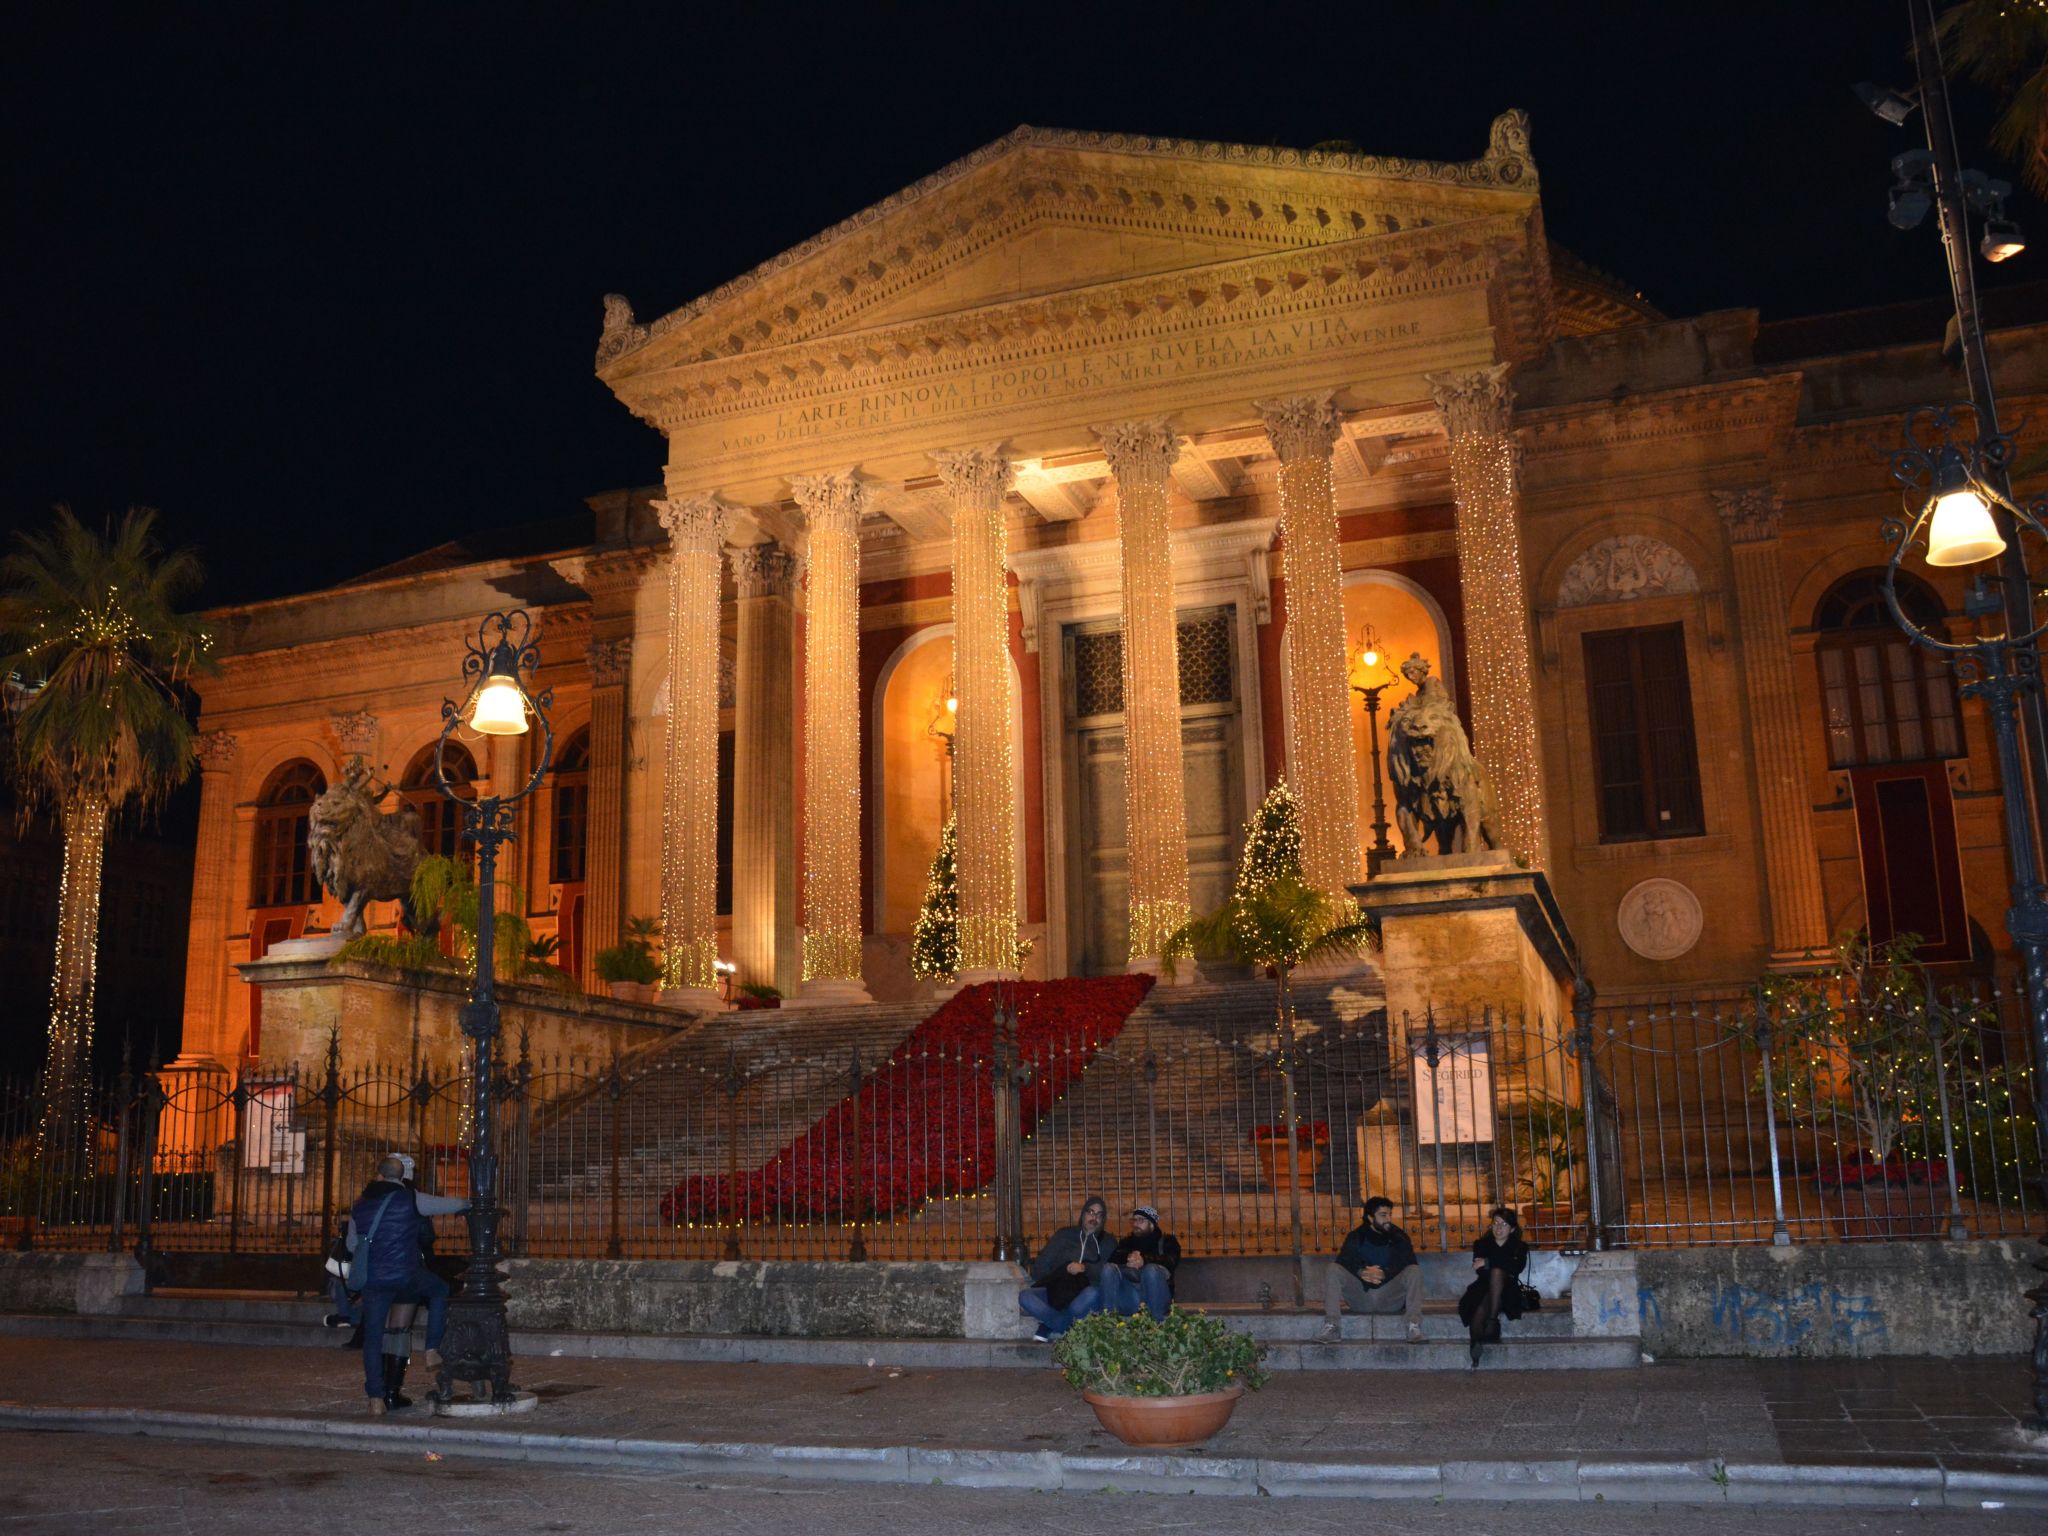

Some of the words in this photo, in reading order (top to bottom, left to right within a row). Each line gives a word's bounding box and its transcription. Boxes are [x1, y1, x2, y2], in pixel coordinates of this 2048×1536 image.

[776, 424, 822, 441] DELLE
[835, 411, 893, 432] SCENE
[903, 404, 920, 418] IL
[931, 391, 1003, 414] DILETTO
[1017, 383, 1050, 399] OVE
[1065, 374, 1104, 389] NON
[1120, 364, 1163, 382] MIRI
[1196, 342, 1295, 369] PREPARAR
[861, 384, 959, 413] RINNOVA
[991, 363, 1068, 390] POPOLI
[1083, 359, 1093, 373] E
[1107, 351, 1135, 369] NE
[1151, 336, 1235, 362] RIVELA
[1252, 328, 1277, 345] LA
[1291, 317, 1349, 337] VITA
[1422, 1069, 1483, 1081] SEGFRIED
